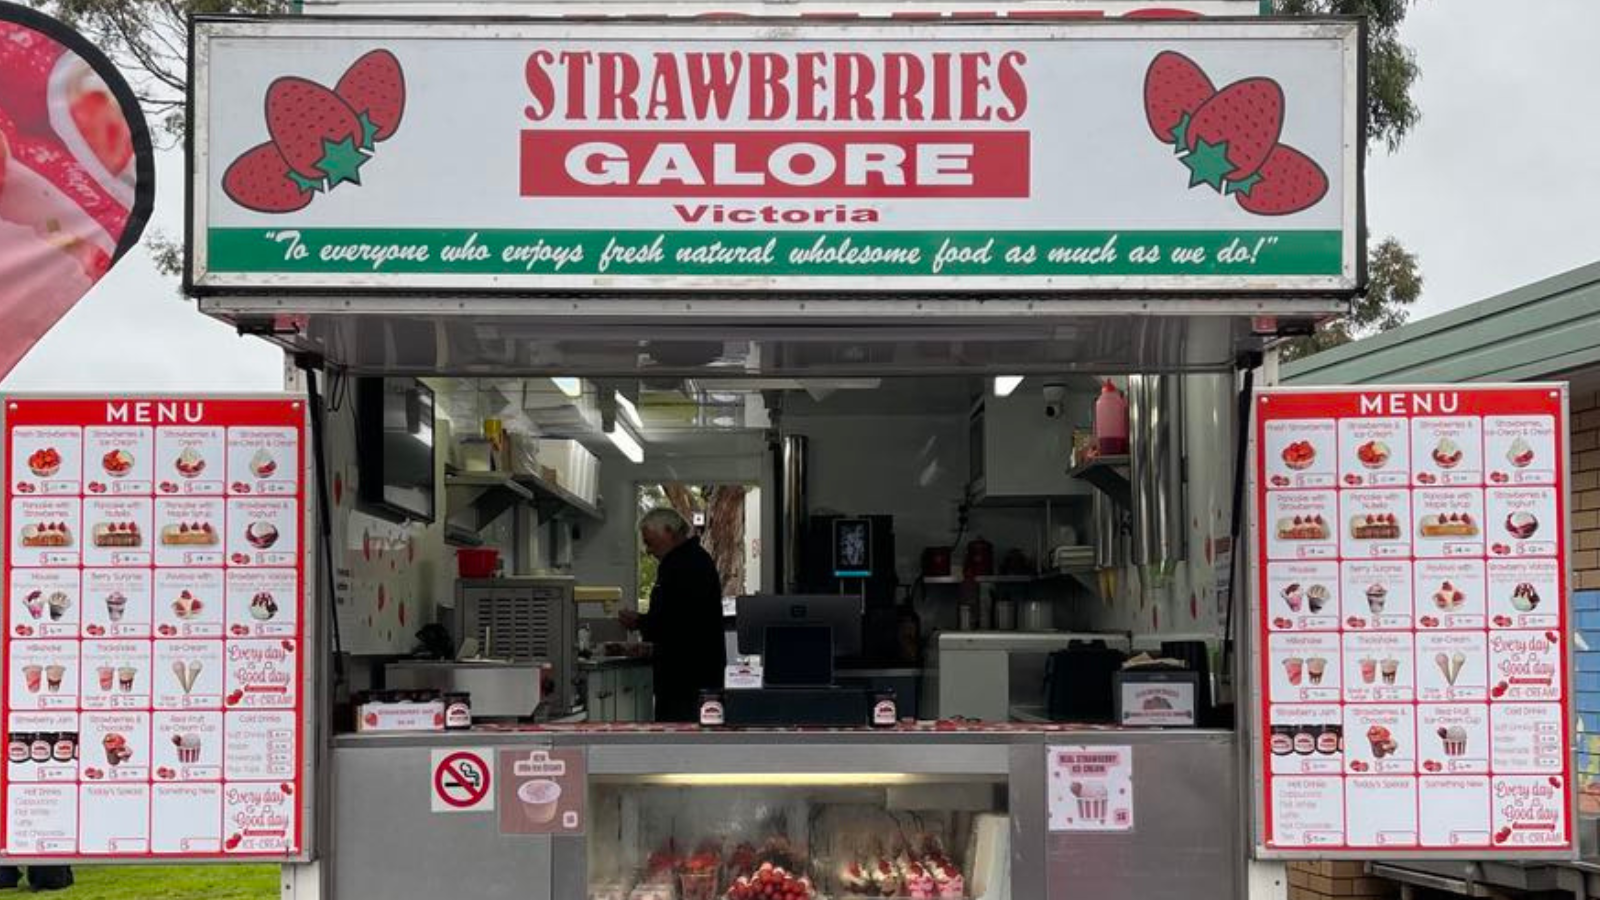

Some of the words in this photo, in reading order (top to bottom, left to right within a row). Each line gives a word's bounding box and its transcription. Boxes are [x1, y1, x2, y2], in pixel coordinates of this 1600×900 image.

[525, 51, 1027, 121] STRAWBERRIES
[564, 142, 974, 185] GALORE
[675, 205, 878, 224] Victoria
[320, 244, 430, 269] everyone
[440, 233, 491, 262] who
[502, 239, 584, 271] enjoys
[598, 235, 665, 272] fresh
[675, 238, 777, 264] natural
[789, 236, 921, 264] wholesome
[932, 239, 994, 273] food
[1005, 246, 1037, 264] as
[1047, 235, 1118, 264] much
[1128, 245, 1160, 263] as
[1171, 247, 1206, 264] we
[106, 402, 203, 422] MENU
[1360, 393, 1458, 414] MENU
[228, 645, 263, 662] Every
[264, 645, 287, 662] day
[1491, 636, 1527, 654] Every
[1528, 636, 1550, 654] day
[234, 668, 266, 685] Good
[267, 668, 291, 685] day
[1498, 660, 1531, 676] Good
[1532, 660, 1555, 676] day
[226, 788, 261, 805] Every
[263, 788, 285, 805] day
[1494, 782, 1530, 799] Every
[1532, 782, 1554, 799] day
[233, 812, 265, 829] Good
[266, 812, 289, 829] day
[1502, 805, 1534, 822] Good
[1536, 805, 1559, 822] day
